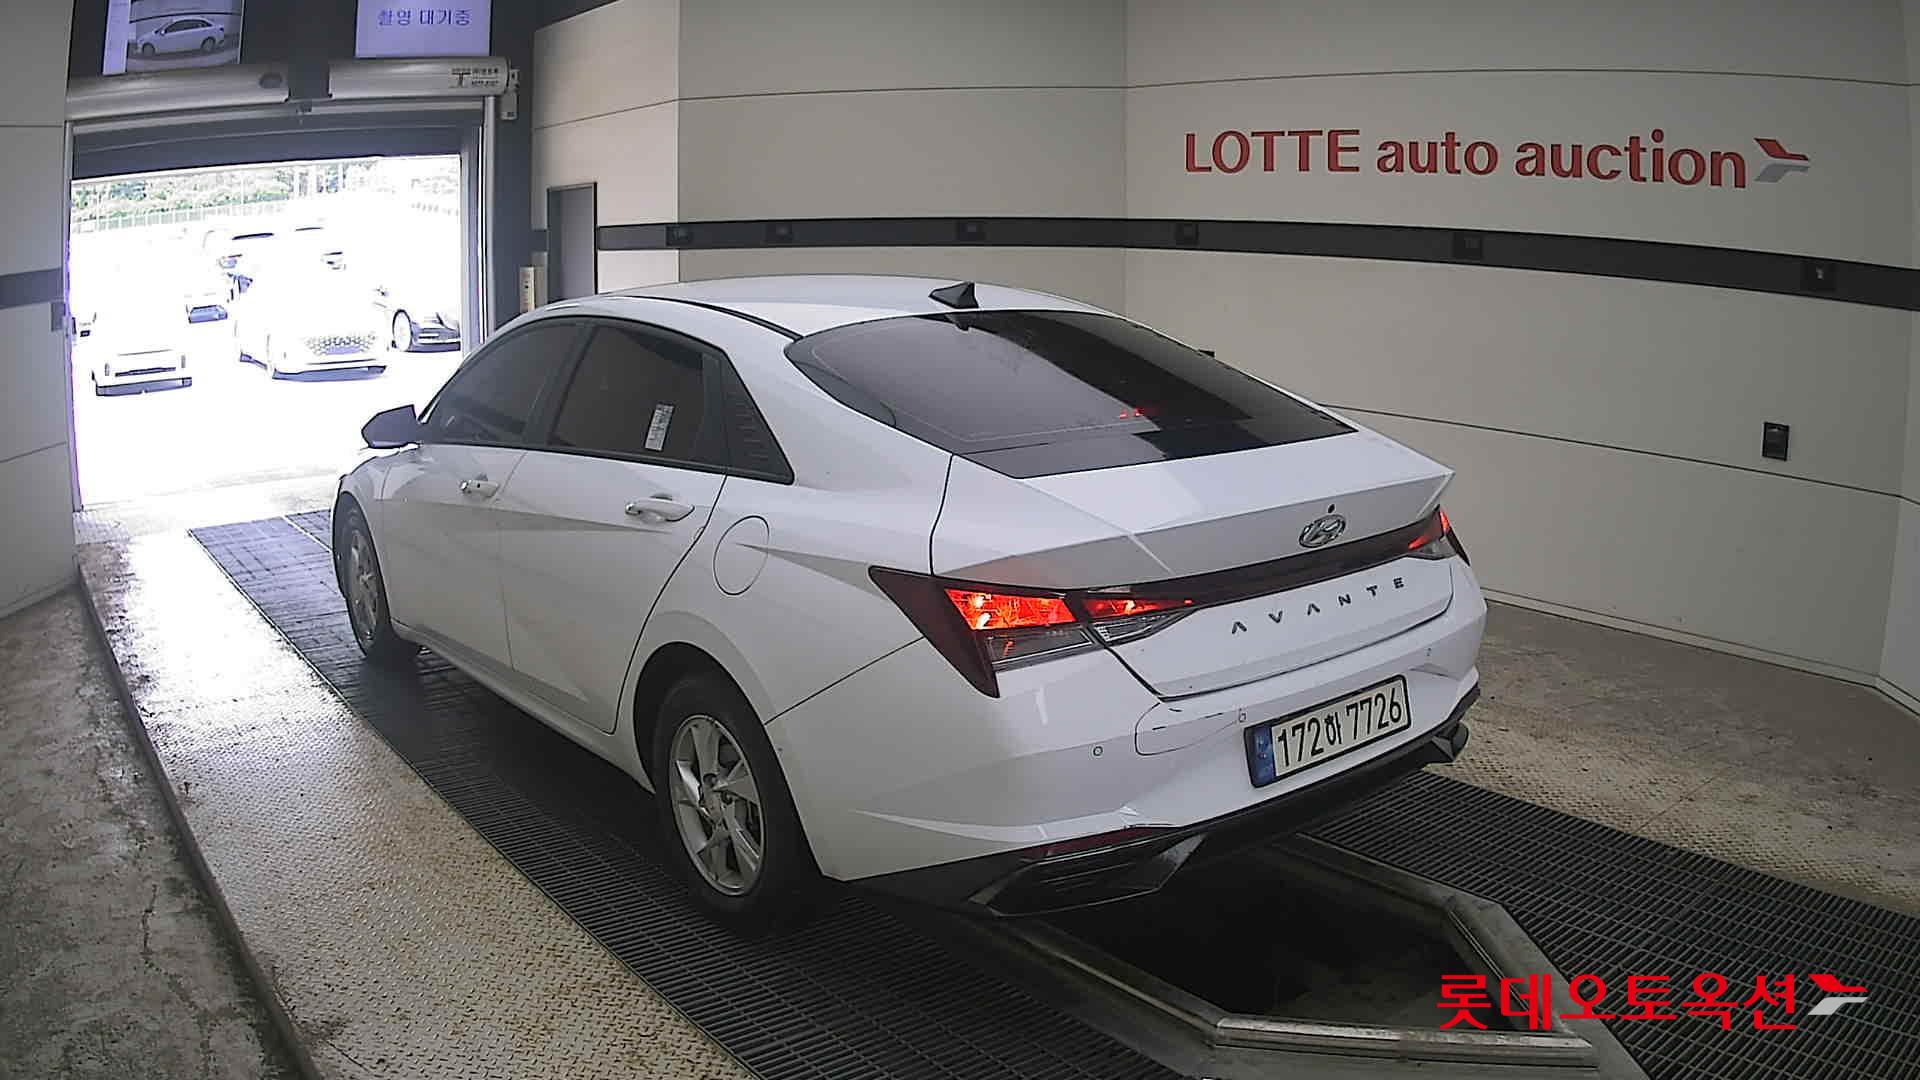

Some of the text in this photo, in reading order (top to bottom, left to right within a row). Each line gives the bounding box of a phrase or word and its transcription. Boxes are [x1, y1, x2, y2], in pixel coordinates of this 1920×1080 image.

[377, 8, 472, 27] 촬영 대기중
[1185, 128, 1747, 189] LOTTE auto auction
[1231, 577, 1406, 636] AVANTE
[1276, 686, 1402, 768] 172하 7726
